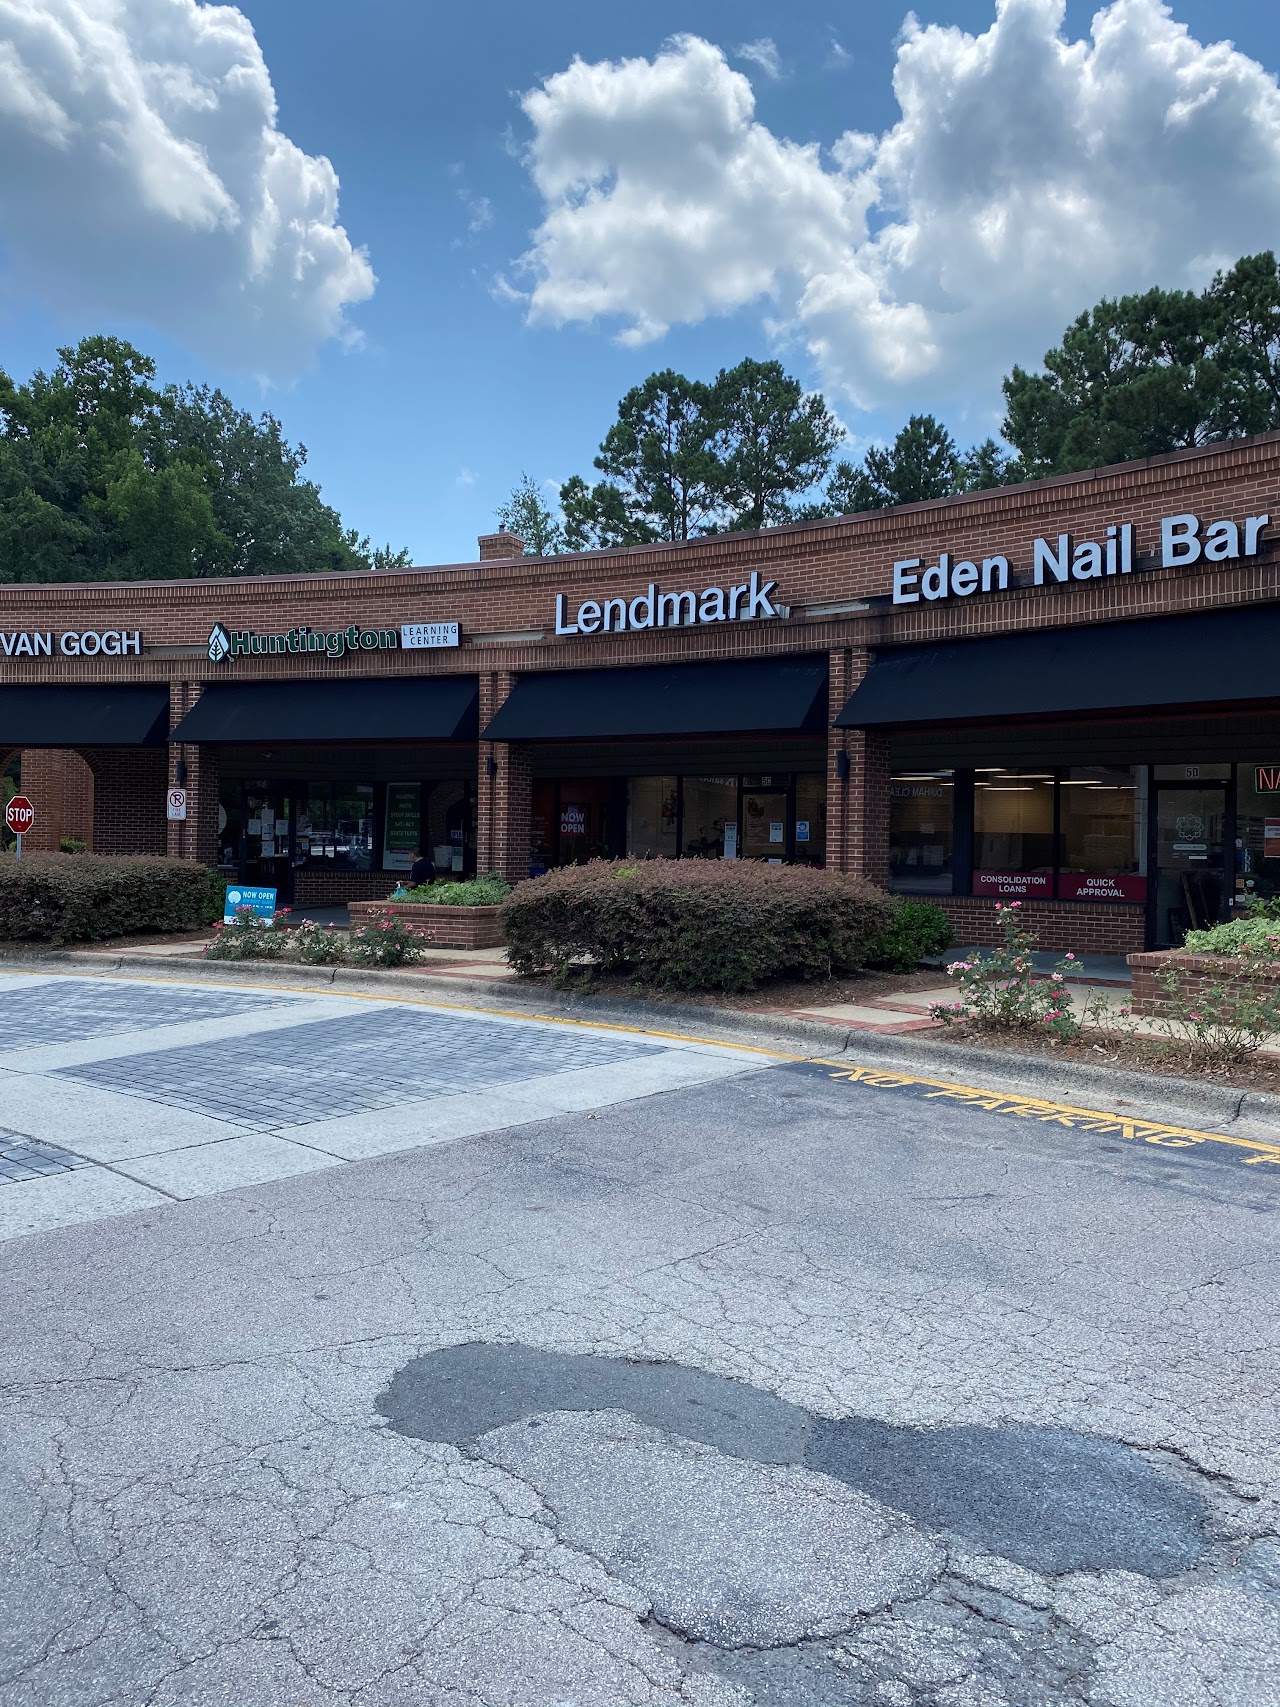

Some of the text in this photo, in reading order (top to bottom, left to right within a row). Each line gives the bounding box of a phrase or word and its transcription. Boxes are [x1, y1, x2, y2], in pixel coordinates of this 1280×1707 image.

[893, 513, 1269, 605] Eden Nail Bar
[555, 571, 778, 635] Lendmark
[403, 625, 458, 637] LEARNING
[0, 630, 141, 656] VAN GOGH
[231, 624, 398, 658] Huntington
[410, 635, 449, 646] CENTER
[1186, 768, 1199, 778] 5D
[7, 807, 33, 822] STOP
[561, 812, 585, 823] NOW
[560, 823, 585, 834] OPEN
[980, 875, 1046, 885] CONSOLIDATION
[1086, 878, 1115, 887] QUICK
[998, 885, 1027, 893] LOANS
[1076, 887, 1125, 897] APPROVAL
[242, 891, 274, 900] NOW OPEN
[828, 1066, 1206, 1148] NO PARKING
